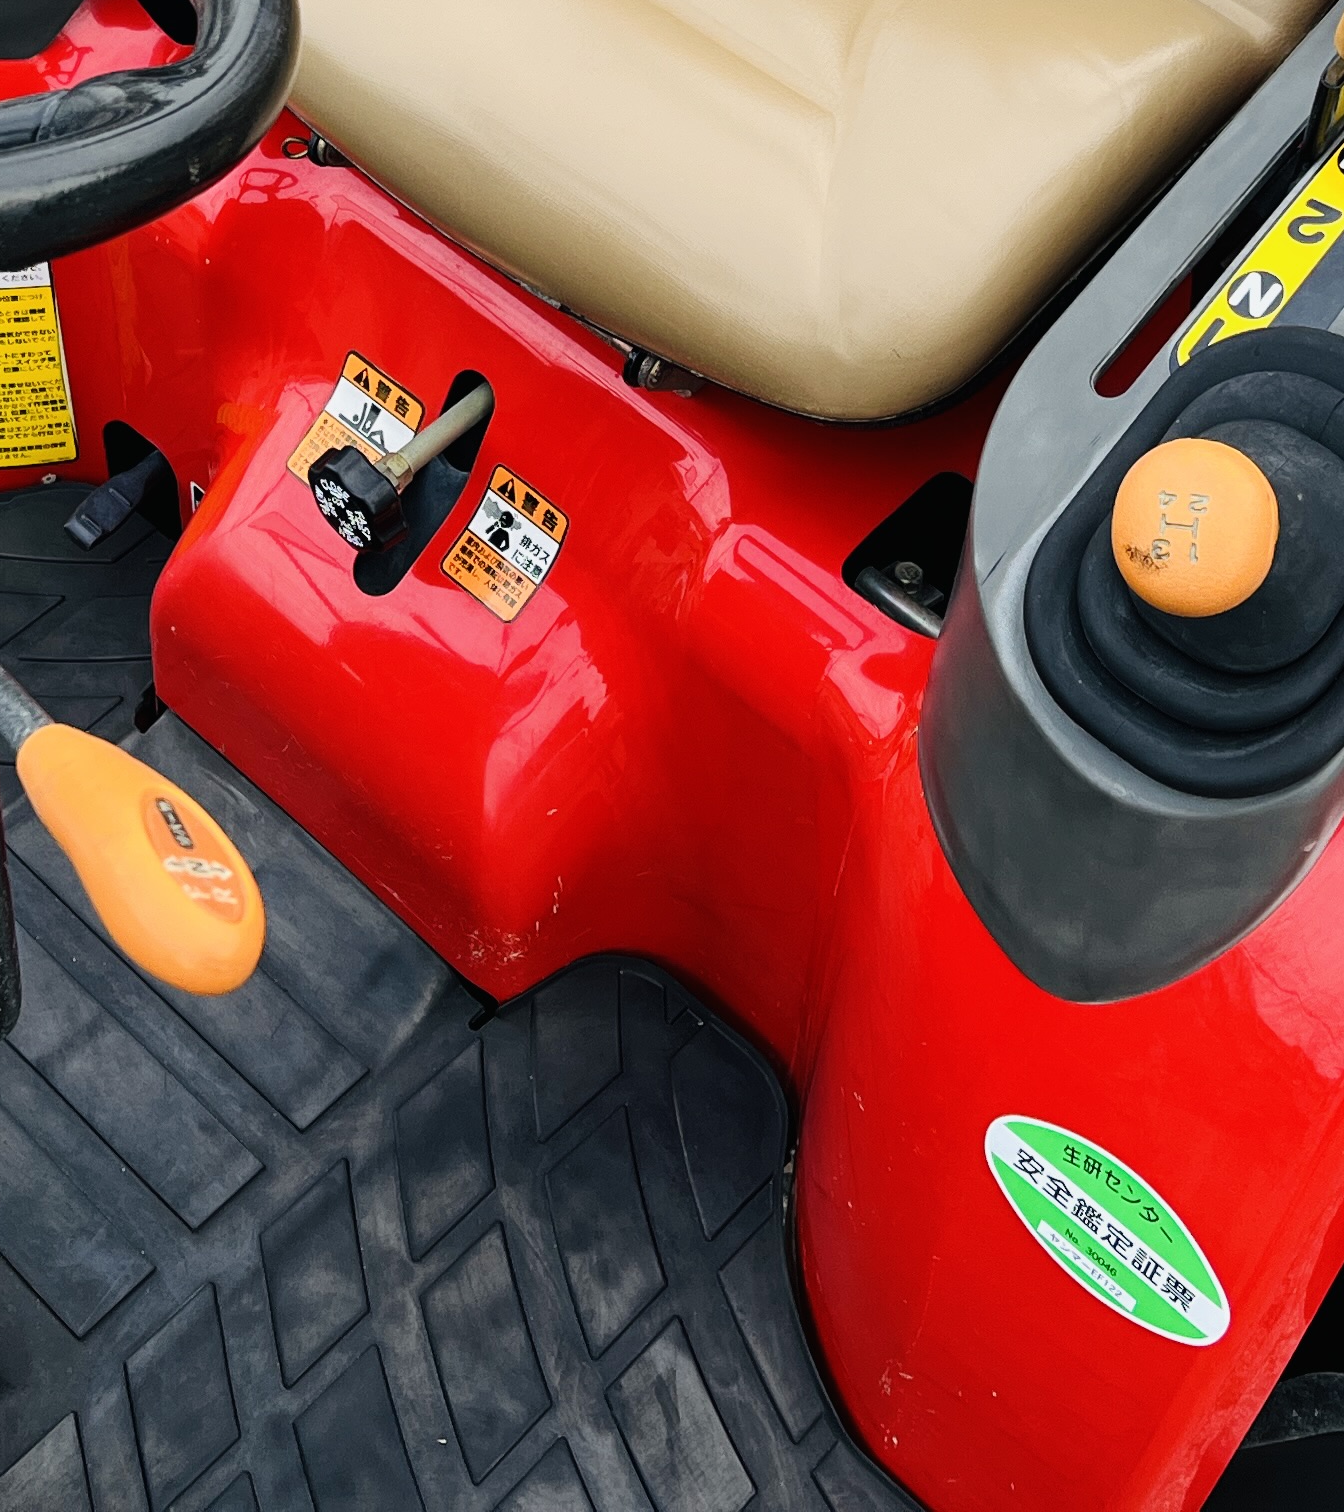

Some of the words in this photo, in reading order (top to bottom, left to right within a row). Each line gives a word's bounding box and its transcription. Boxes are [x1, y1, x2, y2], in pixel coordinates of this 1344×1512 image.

[1287, 198, 1343, 245] 2
[1227, 272, 1281, 317] N
[375, 379, 410, 419] 警告
[520, 491, 559, 534] 警告
[1158, 490, 1178, 509] 4
[1188, 493, 1211, 514] 2
[510, 548, 544, 580] に注意
[518, 534, 551, 566] 排ガス
[1151, 538, 1171, 560] 3
[1189, 542, 1199, 565] 1
[1062, 1143, 1174, 1244] 生研センター
[1013, 1148, 1196, 1313] 安全鑑定証票
[1050, 1232, 1123, 1299] ヤンマーEF122
[1085, 1246, 1118, 1278] 30046
